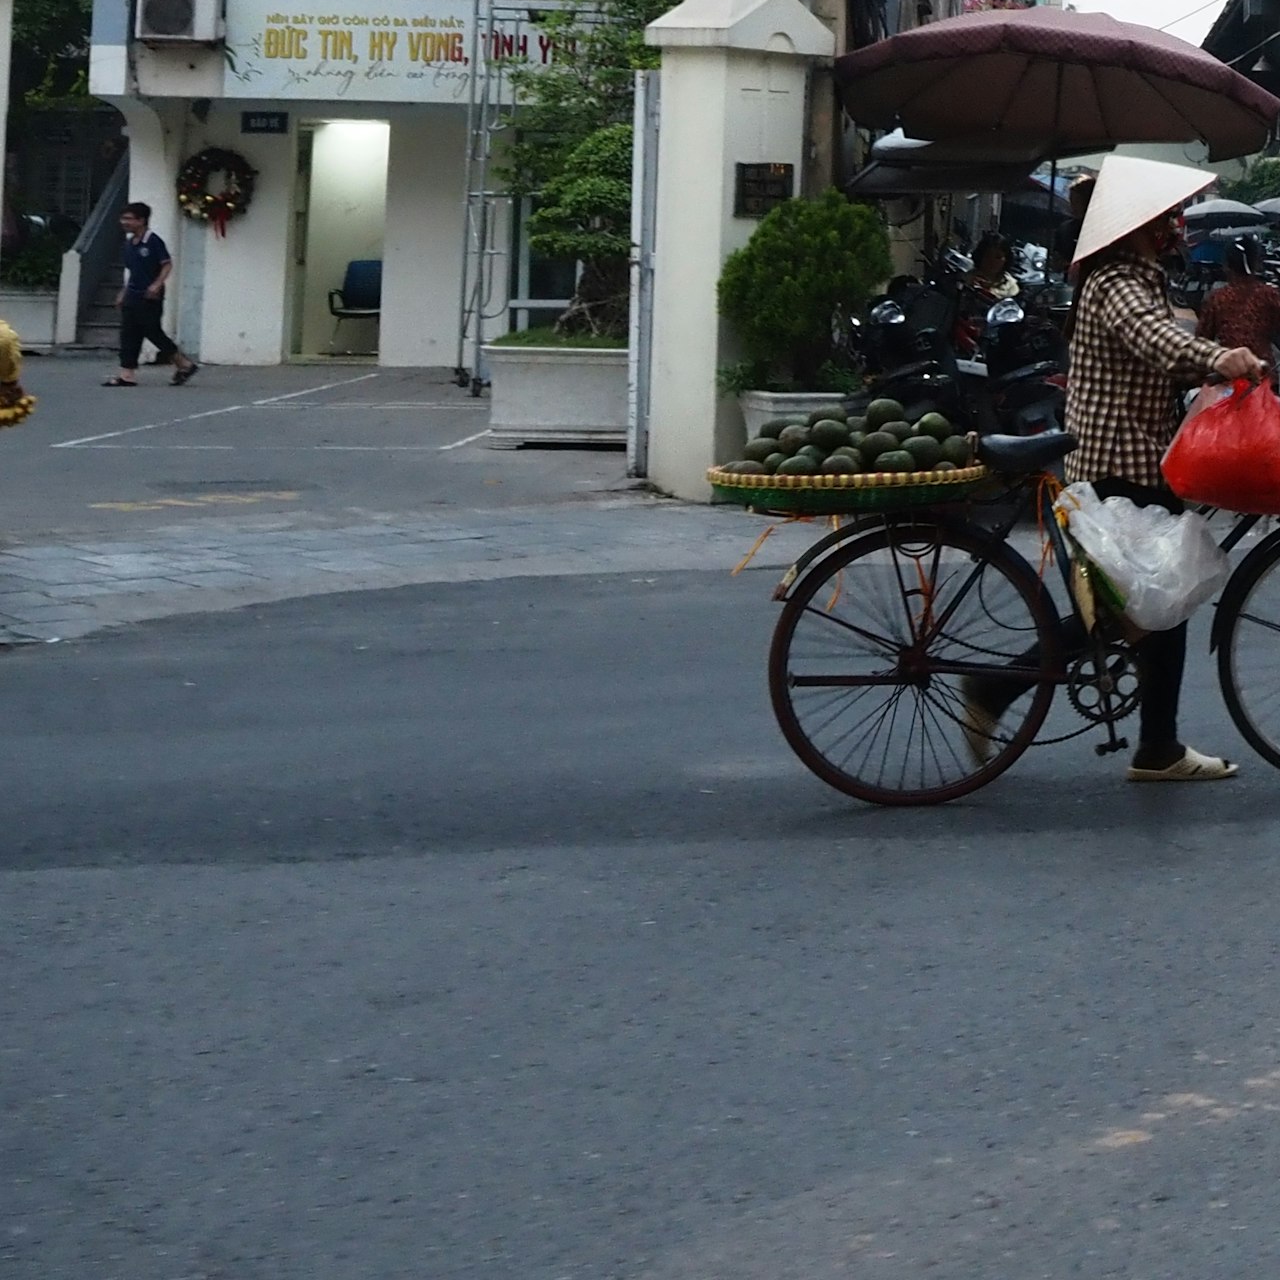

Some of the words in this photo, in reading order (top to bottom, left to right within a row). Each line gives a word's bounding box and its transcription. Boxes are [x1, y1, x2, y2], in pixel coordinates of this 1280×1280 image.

[264, 25, 308, 59] ĐỨC
[318, 30, 359, 64] TIN,
[369, 31, 398, 61] HY
